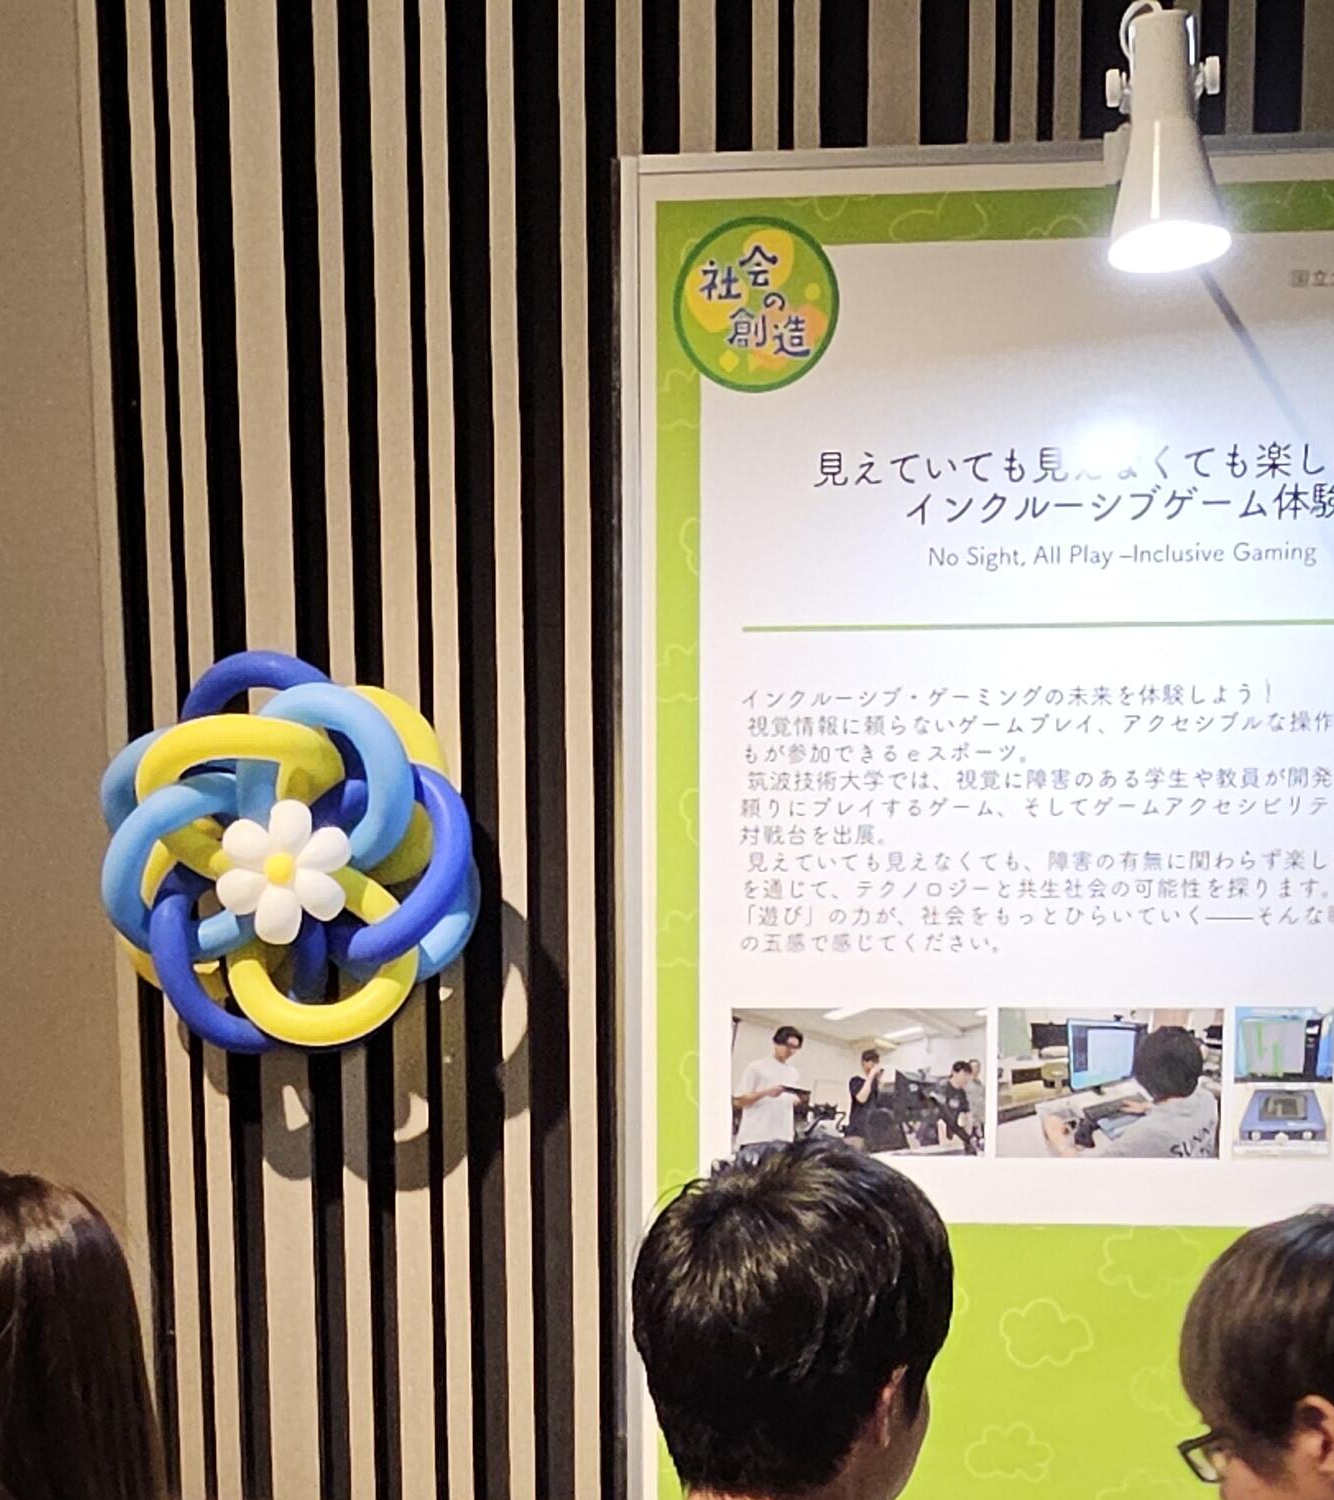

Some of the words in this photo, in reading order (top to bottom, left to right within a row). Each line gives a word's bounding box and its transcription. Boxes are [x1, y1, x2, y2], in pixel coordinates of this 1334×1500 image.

[728, 307, 811, 357] 創造
[929, 547, 959, 567] No
[967, 545, 1025, 572] Sight,
[1033, 545, 1061, 565] All
[1069, 544, 1114, 570] Play
[1233, 540, 1318, 567] Gaming
[742, 680, 1271, 708] インクルーシブ・ゲーミングの未来を体験しよう！
[739, 824, 885, 845] 対戦台を出展。
[744, 877, 1330, 900] を通じて、テクノロジーと共生社会の可能性を探ります。
[741, 933, 1000, 953] の五感で感じてください。
